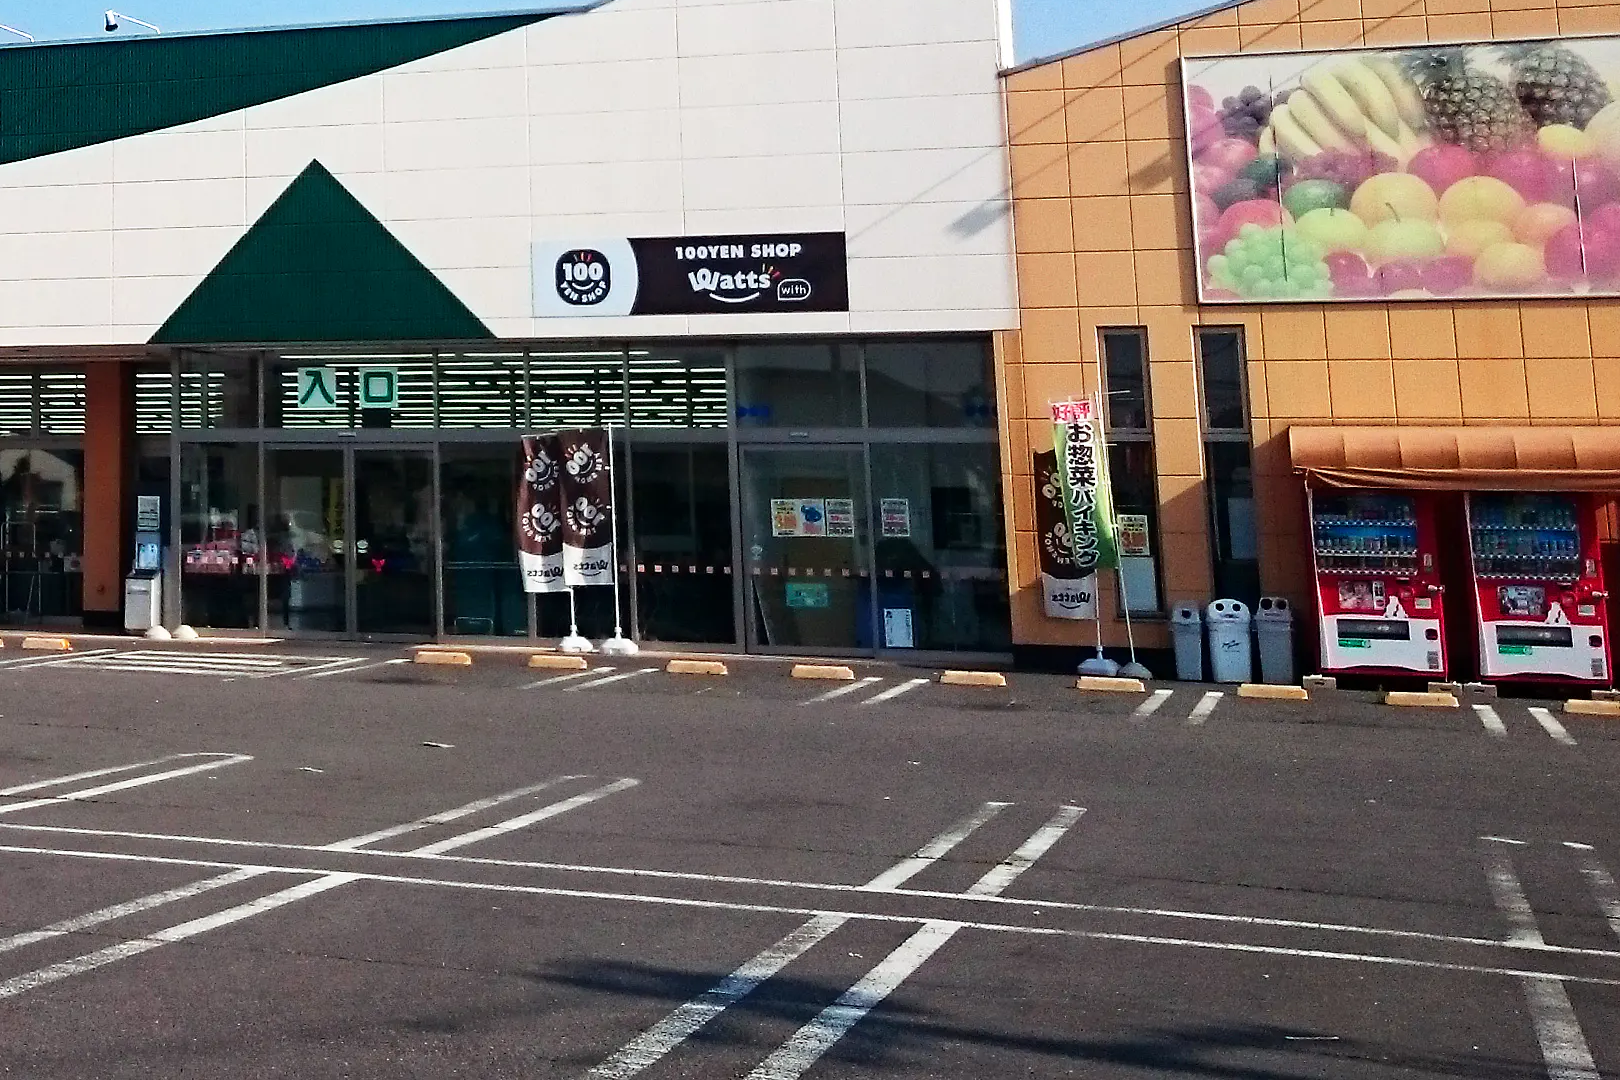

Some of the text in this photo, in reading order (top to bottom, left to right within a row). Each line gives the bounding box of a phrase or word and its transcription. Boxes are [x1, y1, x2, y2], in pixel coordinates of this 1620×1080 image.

[674, 243, 802, 260] 100YEN SHOP
[562, 262, 604, 281] 100
[687, 268, 807, 295] Watts with
[560, 280, 606, 302] YEN SHOP
[300, 370, 394, 405] 入口
[1052, 402, 1090, 421] 好評
[1066, 423, 1099, 567] お惣菜バイキング
